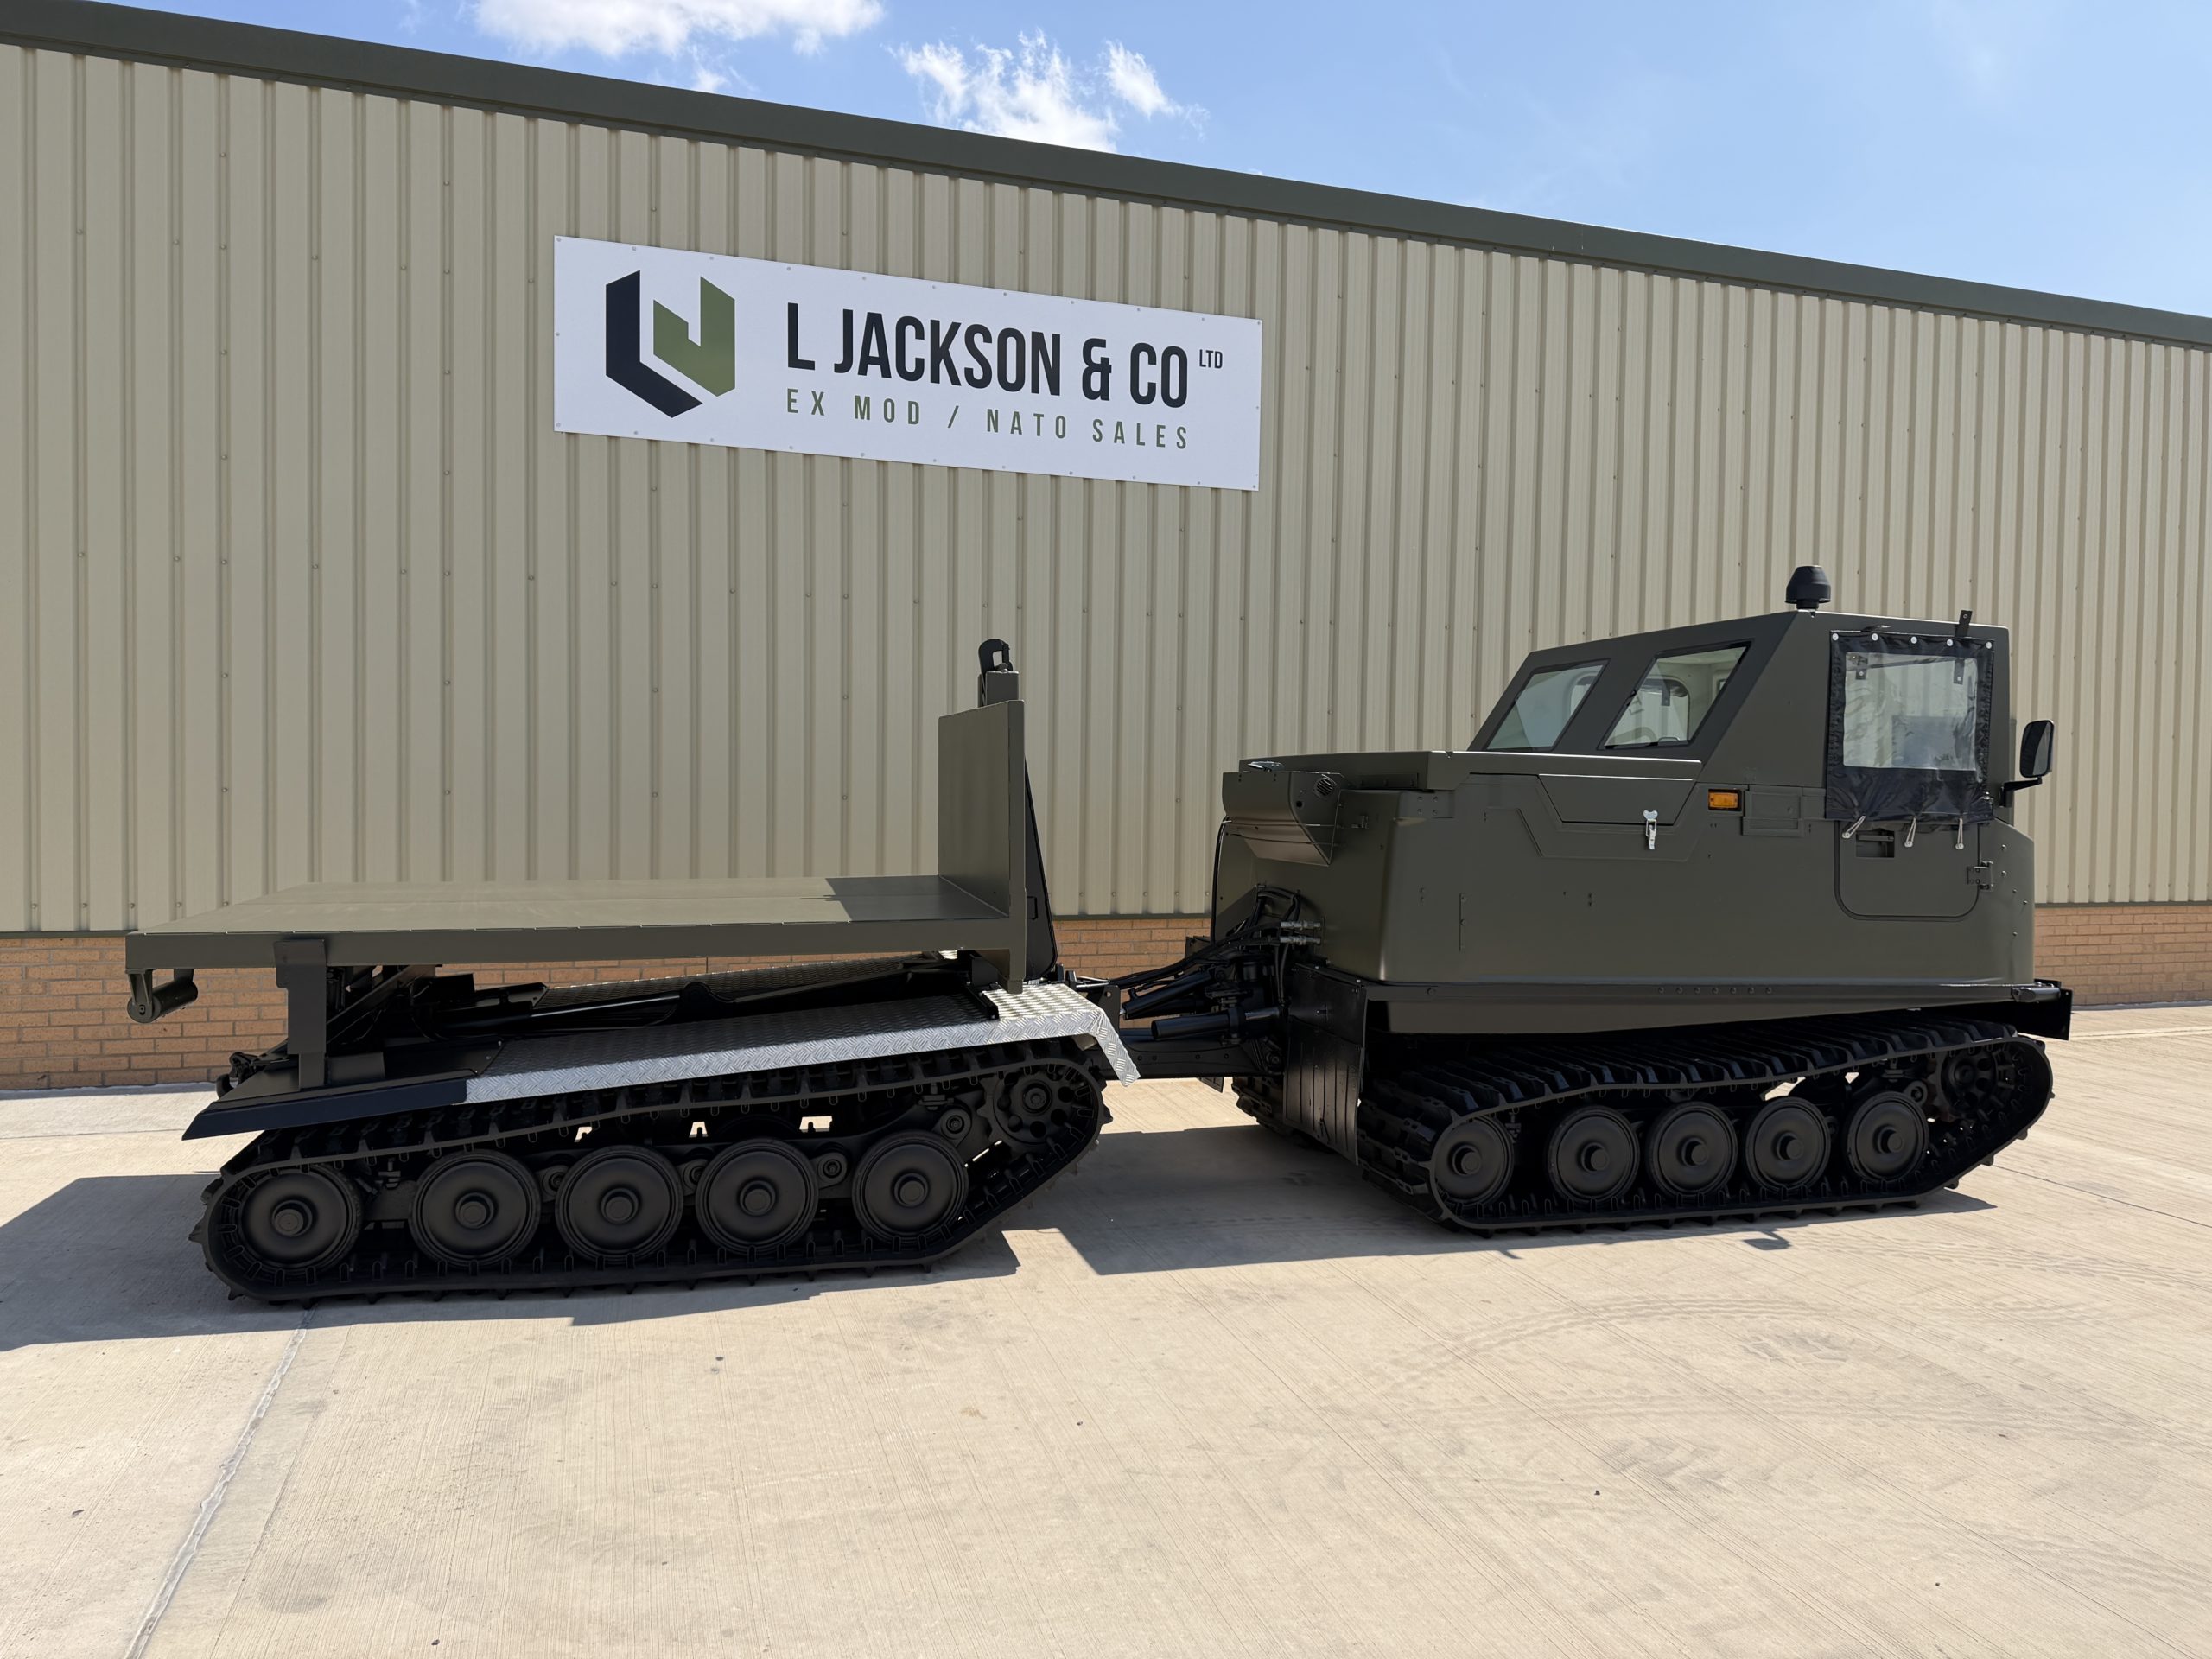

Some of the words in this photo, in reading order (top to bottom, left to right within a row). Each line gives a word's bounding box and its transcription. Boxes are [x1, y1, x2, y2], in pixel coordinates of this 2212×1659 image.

[787, 302, 816, 372] L
[833, 308, 1061, 397] JACKSON
[1081, 337, 1113, 402] &
[1129, 342, 1188, 409] CO
[1198, 348, 1224, 370] LTD
[787, 388, 825, 416] EX
[854, 395, 920, 425] MOD
[987, 408, 1066, 439] NATO
[1092, 418, 1187, 450] SALES
